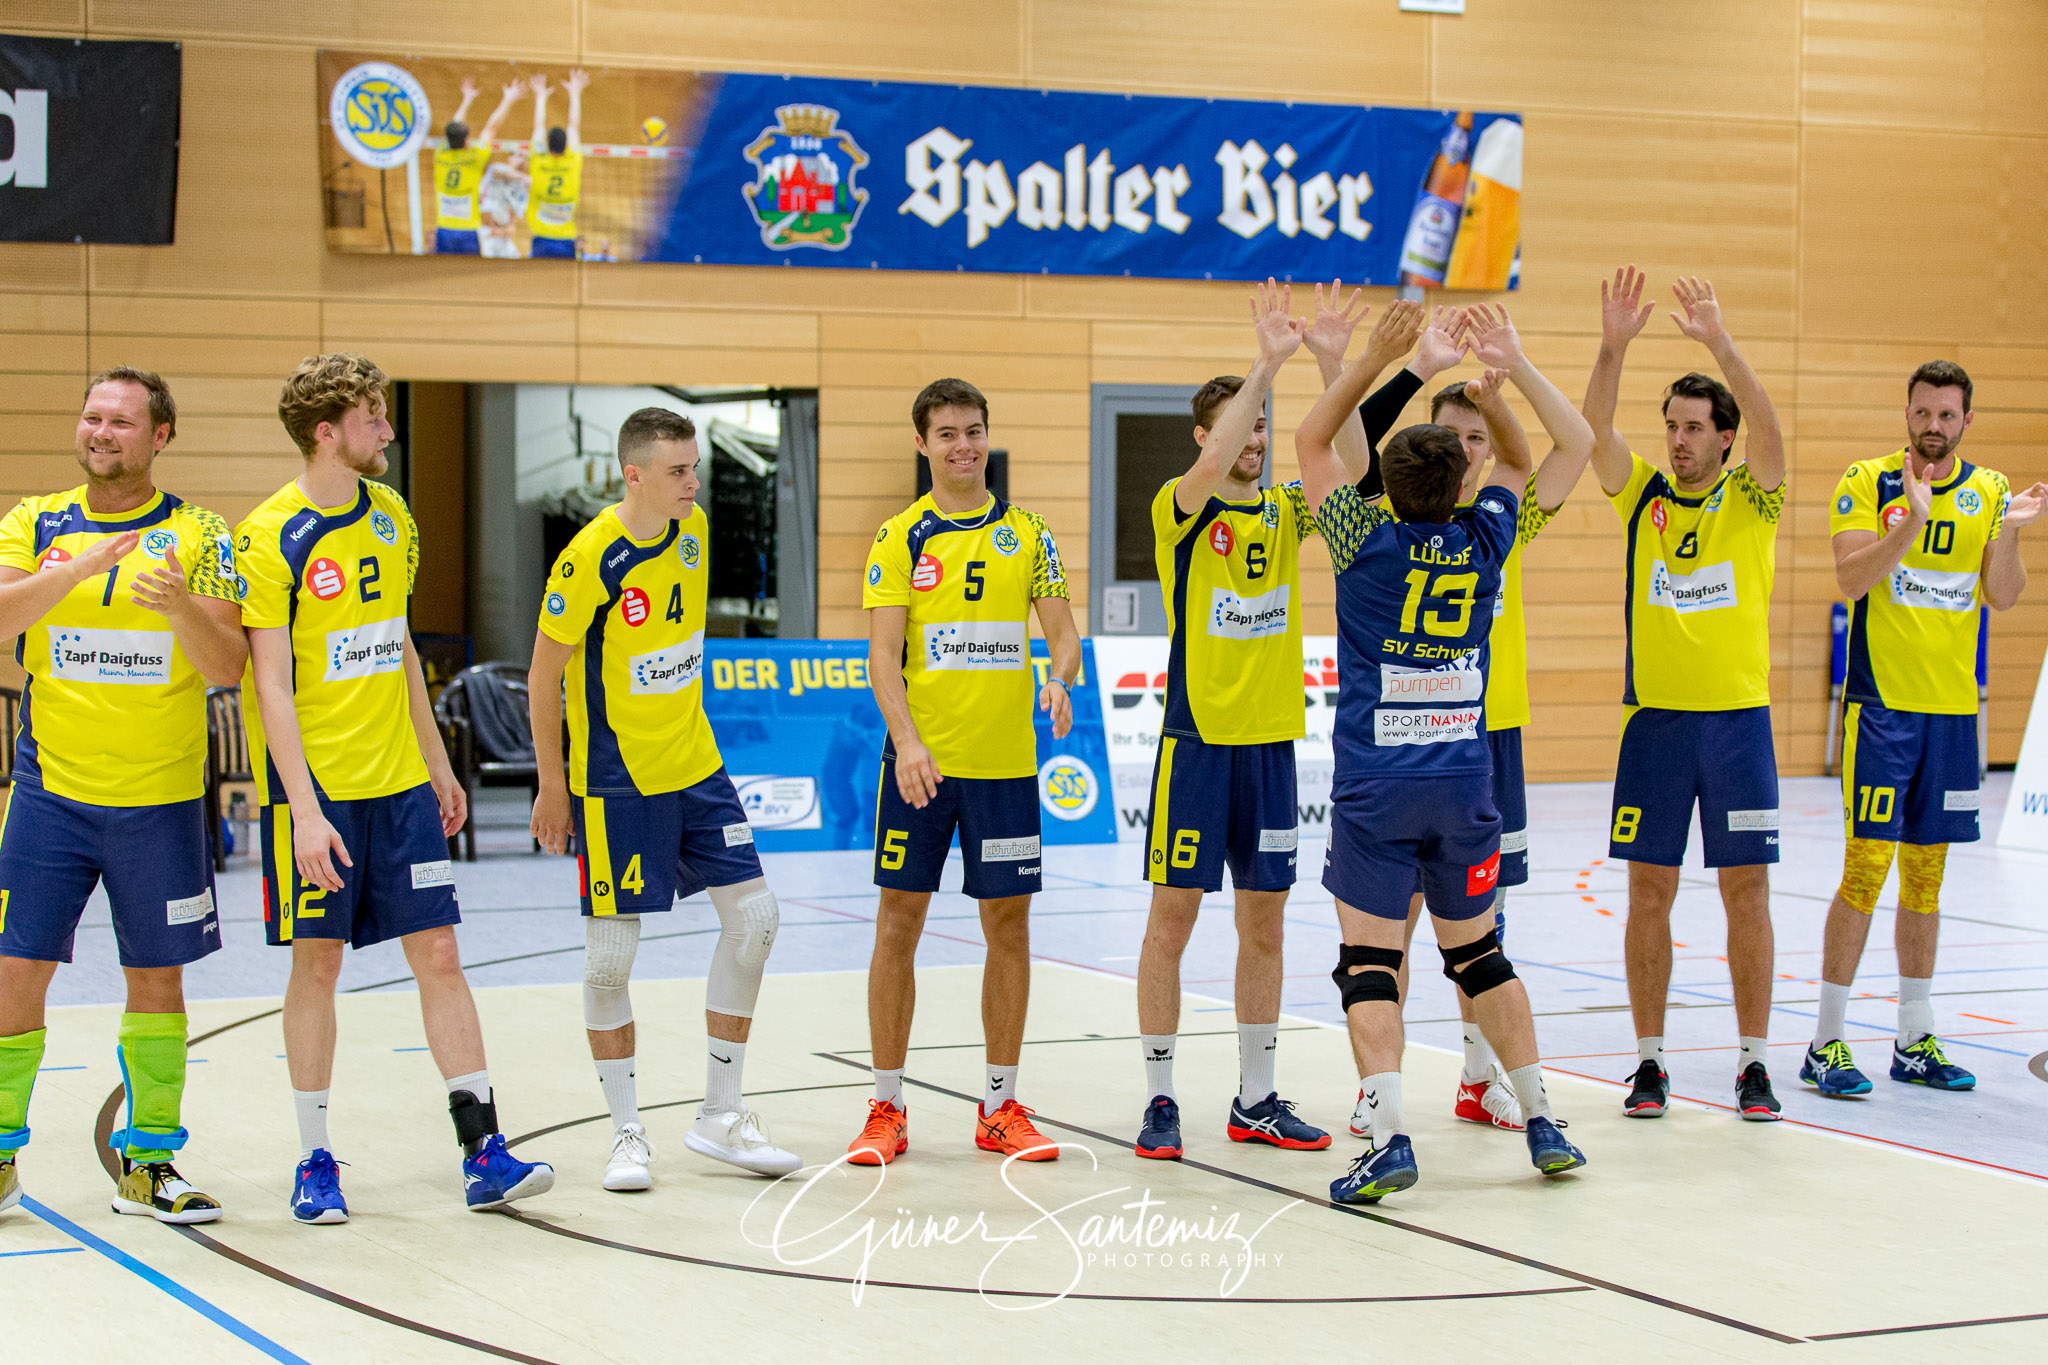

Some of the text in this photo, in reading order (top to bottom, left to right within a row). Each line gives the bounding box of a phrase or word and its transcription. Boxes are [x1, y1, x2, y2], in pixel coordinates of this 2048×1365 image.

[898, 126, 1374, 249] Spalter Bier
[290, 516, 317, 542] Kempa
[1922, 519, 1956, 555] 10
[359, 555, 382, 603] 2
[1246, 542, 1267, 579] 6
[101, 564, 120, 607] 1
[964, 561, 986, 602] 5
[1676, 582, 1728, 600] Daigfuss
[665, 582, 684, 624] 4
[1399, 568, 1480, 638] 13
[65, 650, 163, 668] Zapf Daigfuss
[943, 641, 1019, 656] Zapf Daigfuss
[1382, 639, 1410, 655] SV
[712, 659, 780, 691] DER
[788, 658, 872, 697] JUGE
[1389, 676, 1462, 696] pumpen
[1859, 786, 1895, 823] 10
[1612, 806, 1642, 843] 8
[881, 829, 909, 870] 5
[1171, 829, 1200, 869] 6
[620, 854, 645, 895] 4
[297, 877, 328, 918] 2
